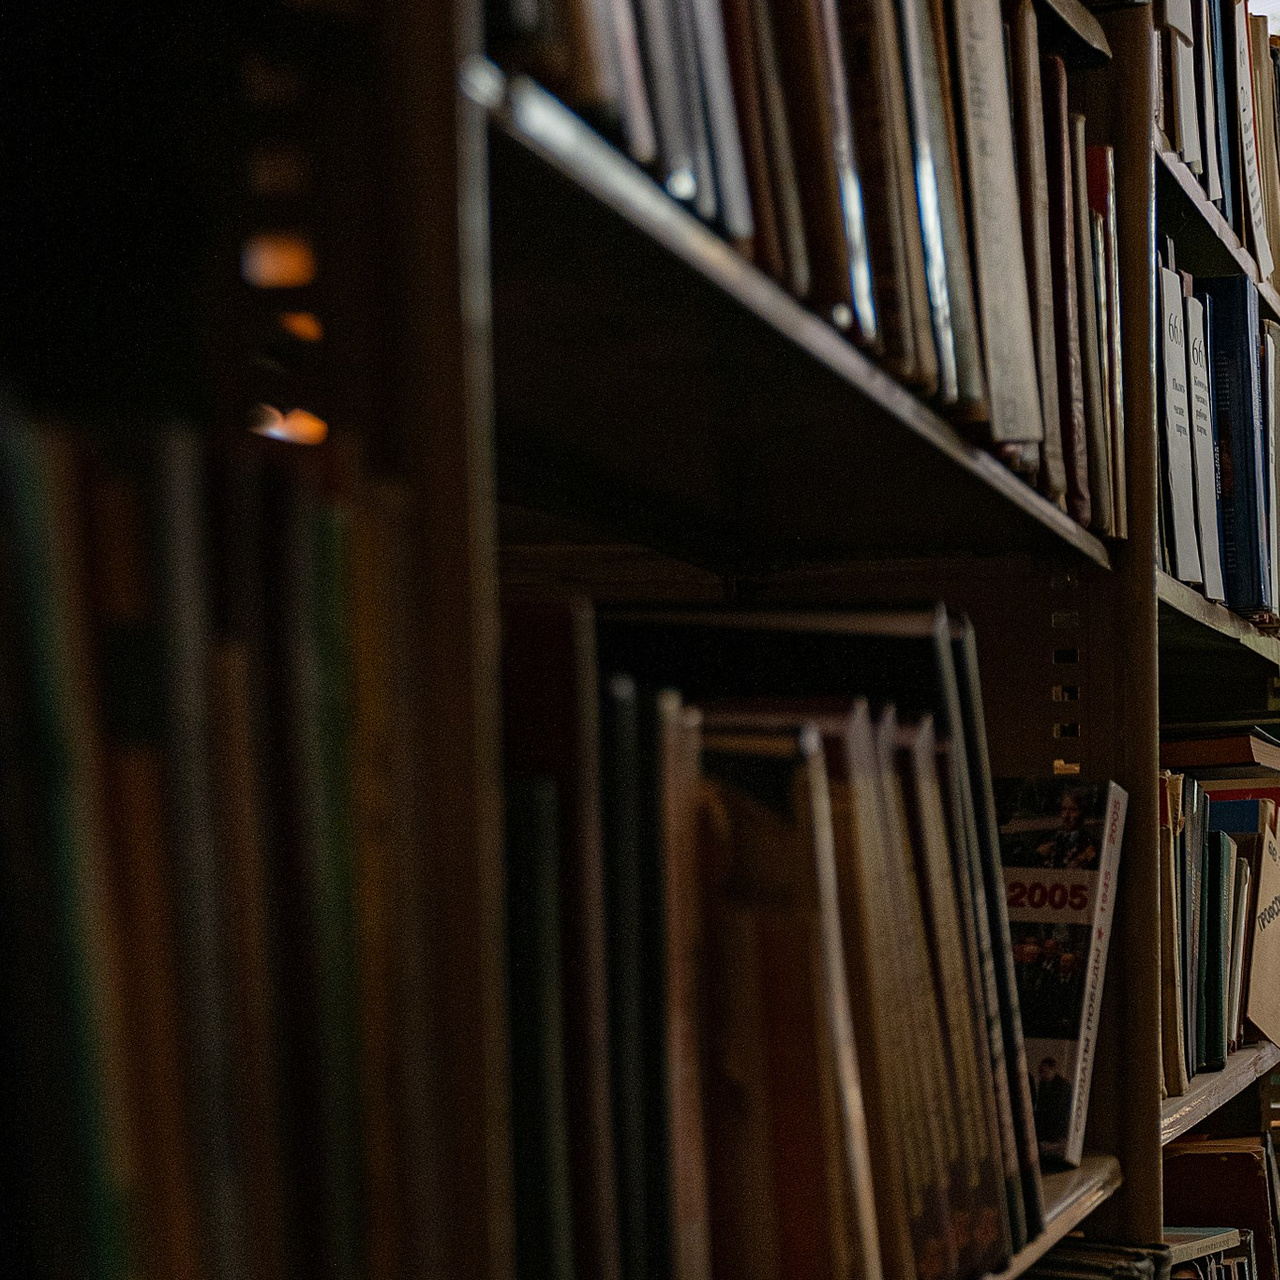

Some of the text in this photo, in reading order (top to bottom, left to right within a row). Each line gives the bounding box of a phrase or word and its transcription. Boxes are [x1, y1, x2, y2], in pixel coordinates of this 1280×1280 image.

[1007, 881, 1088, 911] 2005
[1074, 799, 1120, 1132] СОЛДАТЫ ПОБЕДЫ 1945 2005
